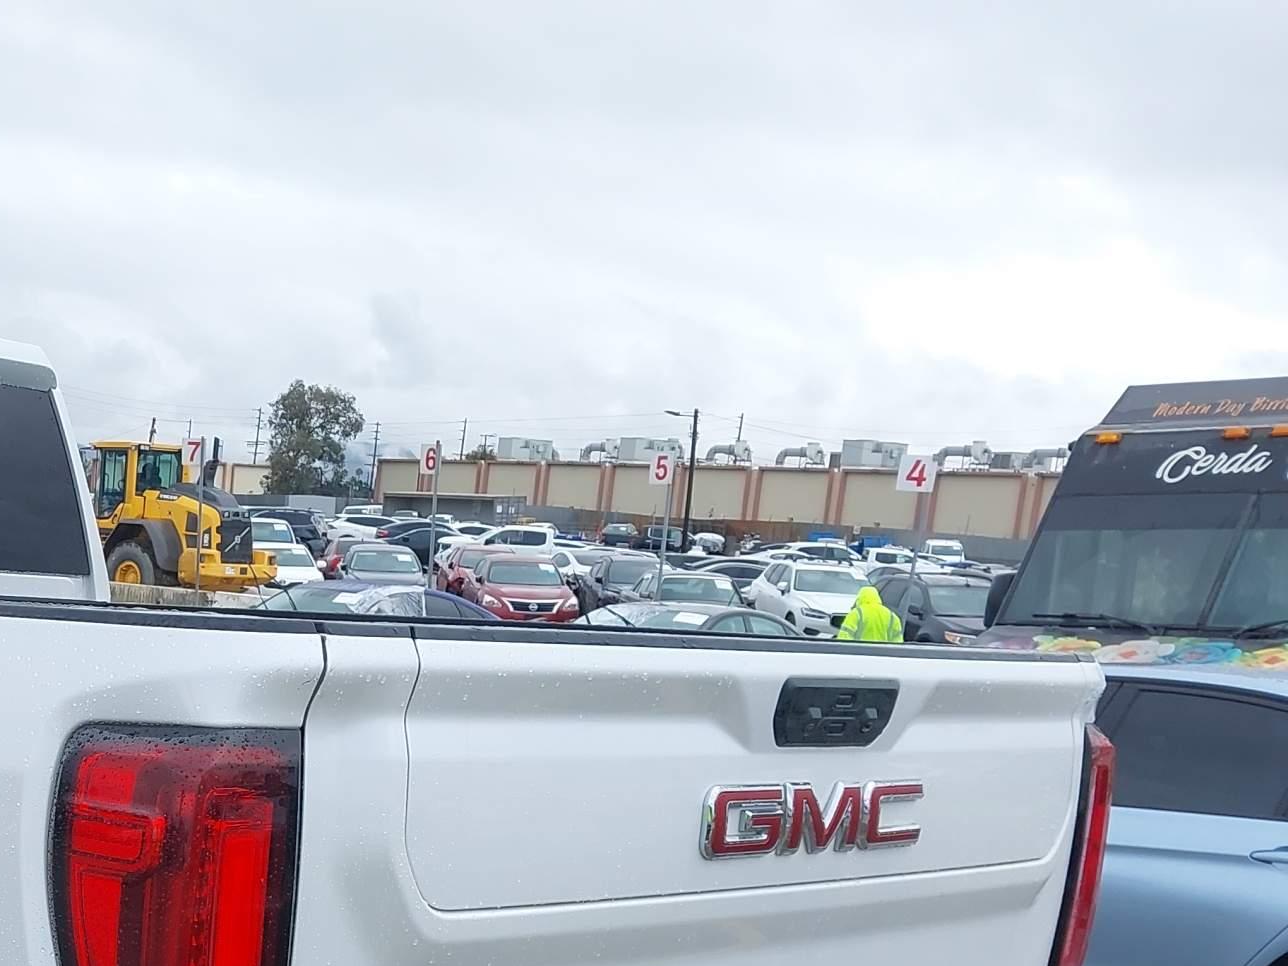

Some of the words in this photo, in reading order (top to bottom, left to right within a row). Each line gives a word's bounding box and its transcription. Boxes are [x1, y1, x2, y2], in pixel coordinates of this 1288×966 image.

[1152, 400, 1212, 418] Modern
[1214, 398, 1246, 417] Day
[1249, 396, 1288, 412] Birri
[187, 441, 201, 462] 7
[425, 447, 437, 471] 6
[1155, 443, 1273, 484] Cerda
[655, 454, 669, 481] 5
[906, 458, 927, 487] 4
[698, 778, 924, 861] GMC
